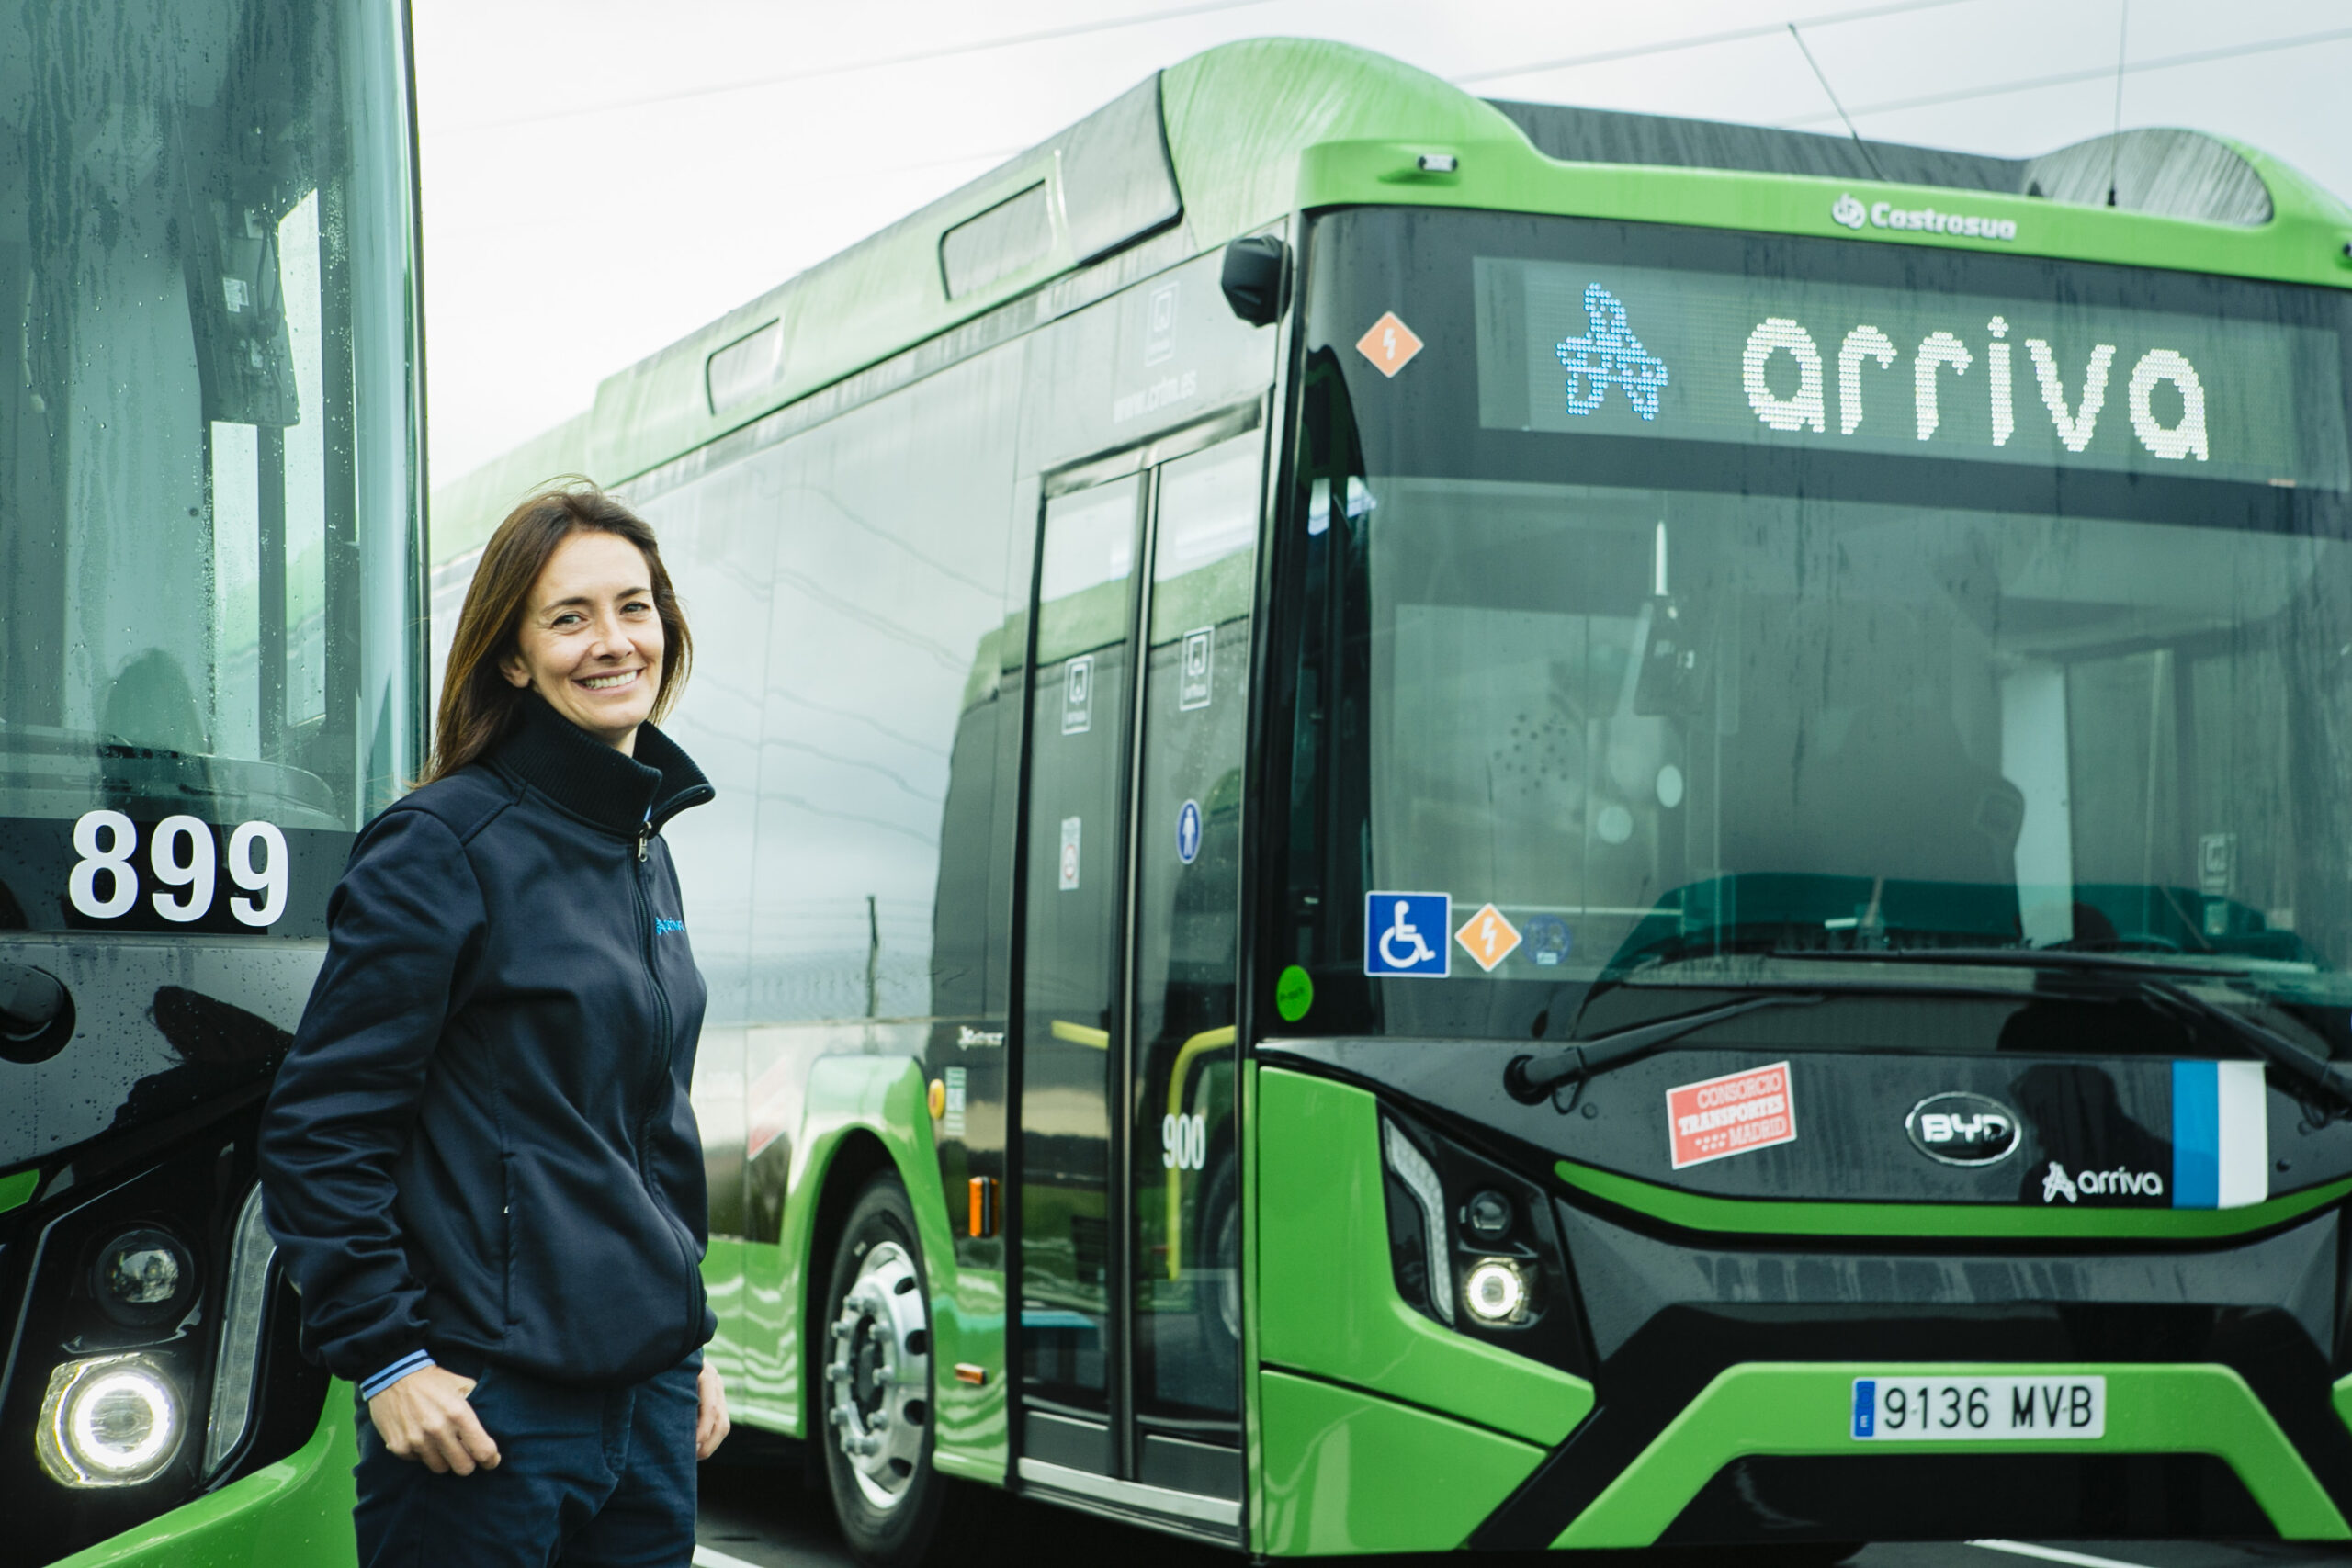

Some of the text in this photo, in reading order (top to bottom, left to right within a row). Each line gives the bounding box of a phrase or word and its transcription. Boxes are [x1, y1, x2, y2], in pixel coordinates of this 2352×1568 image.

[1871, 201, 2018, 241] Castrosua
[1743, 315, 2209, 461] arriva
[68, 809, 289, 927] 899
[1697, 1071, 1783, 1109] CONSORCIO
[1677, 1093, 1786, 1136] TRANSPORTES
[1728, 1115, 1788, 1147] MADRID
[1920, 1113, 2010, 1143] BYD
[1162, 1112, 1206, 1170] 900
[2077, 1166, 2164, 1196] arriva
[1884, 1386, 1990, 1429] 9136
[2011, 1385, 2092, 1429] MVB
